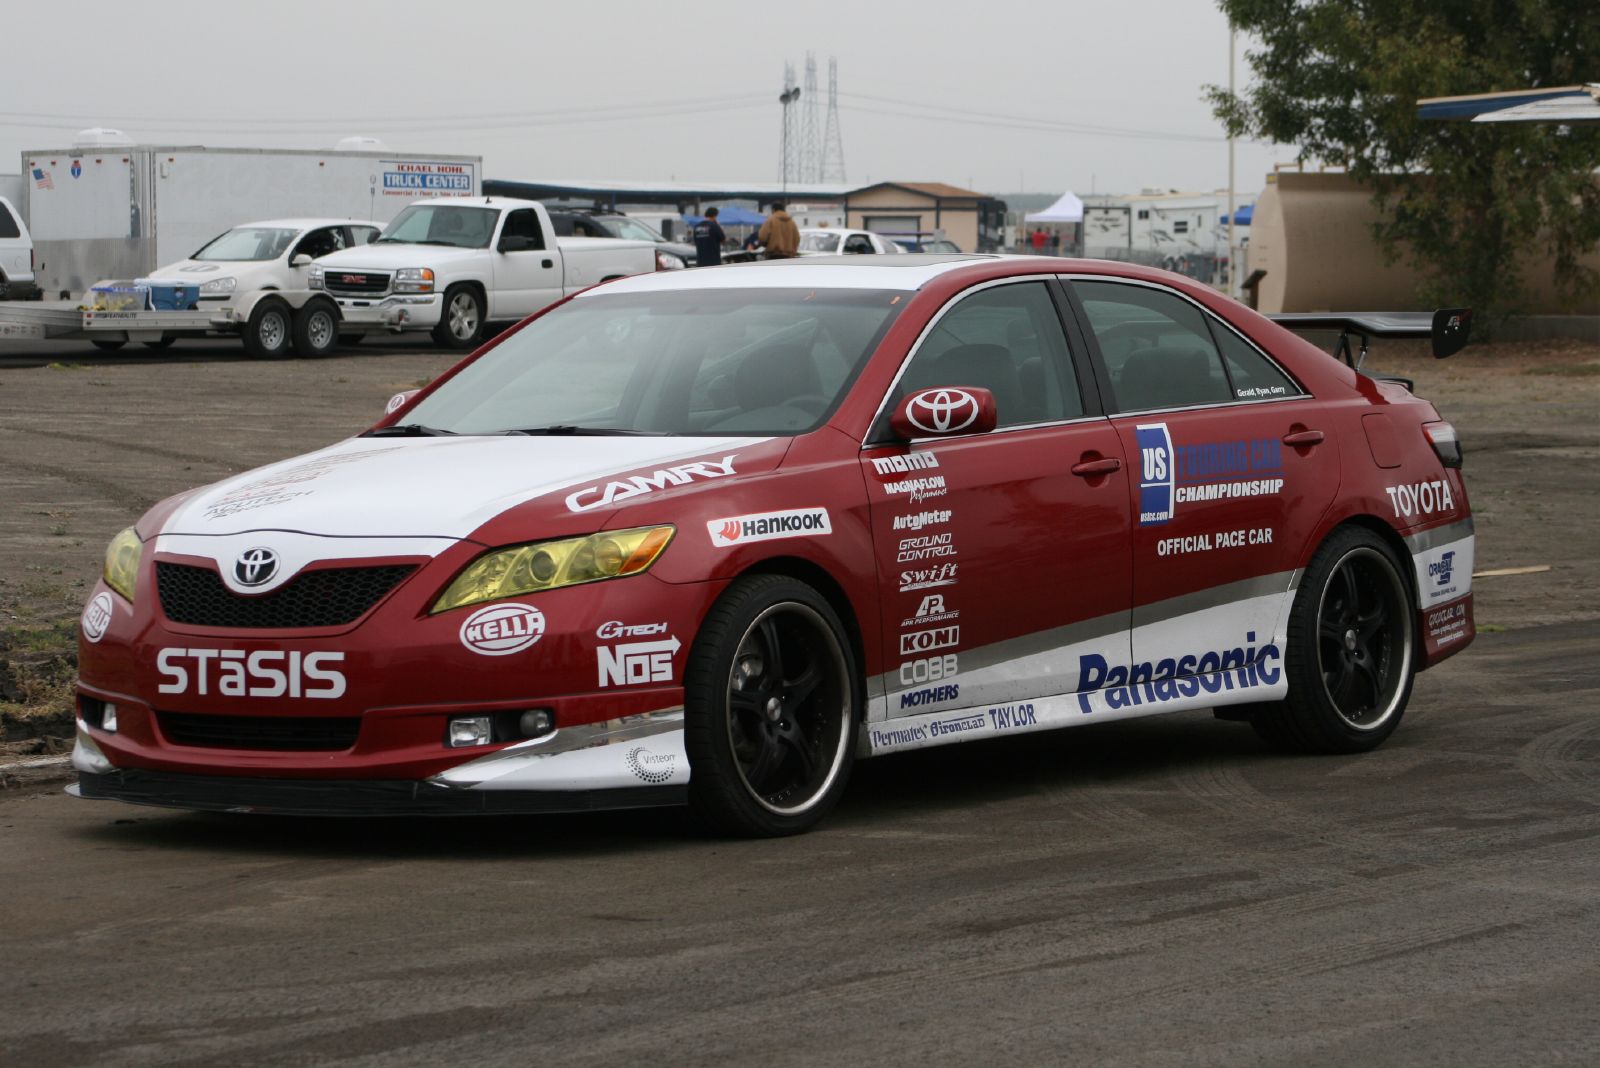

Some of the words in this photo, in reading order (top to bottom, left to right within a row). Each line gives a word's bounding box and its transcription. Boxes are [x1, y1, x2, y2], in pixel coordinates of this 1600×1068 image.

[385, 174, 422, 187] TRUCK
[426, 175, 468, 189] CENTER
[1256, 387, 1271, 397] Ryan,
[1142, 446, 1167, 481] US
[1250, 438, 1282, 471] CAR
[564, 455, 736, 513] CAMRY
[884, 476, 946, 495] MAGNAFLOW
[909, 487, 948, 504] Performance
[1175, 479, 1284, 503] CHAMPIONSHIP
[1385, 479, 1455, 518] TOYOTA
[892, 508, 952, 531] AutoMeter
[897, 545, 957, 563] CONTROL
[898, 533, 952, 551] GROUND
[1157, 532, 1212, 556] OFFICIAL
[1216, 530, 1245, 550] PACE
[1249, 527, 1273, 546] CAR
[900, 563, 959, 584] Swift
[467, 611, 545, 642] HELLA
[914, 612, 960, 625] PERFORMANCE
[902, 628, 959, 653] KONI
[597, 645, 673, 688] NOS
[899, 653, 958, 685] COBB
[1077, 631, 1281, 714] Panasonic
[900, 684, 960, 709] MOTHERS
[872, 724, 927, 748] Permatex
[988, 704, 1037, 730] TAYLOR
[643, 754, 677, 765] Visteon
